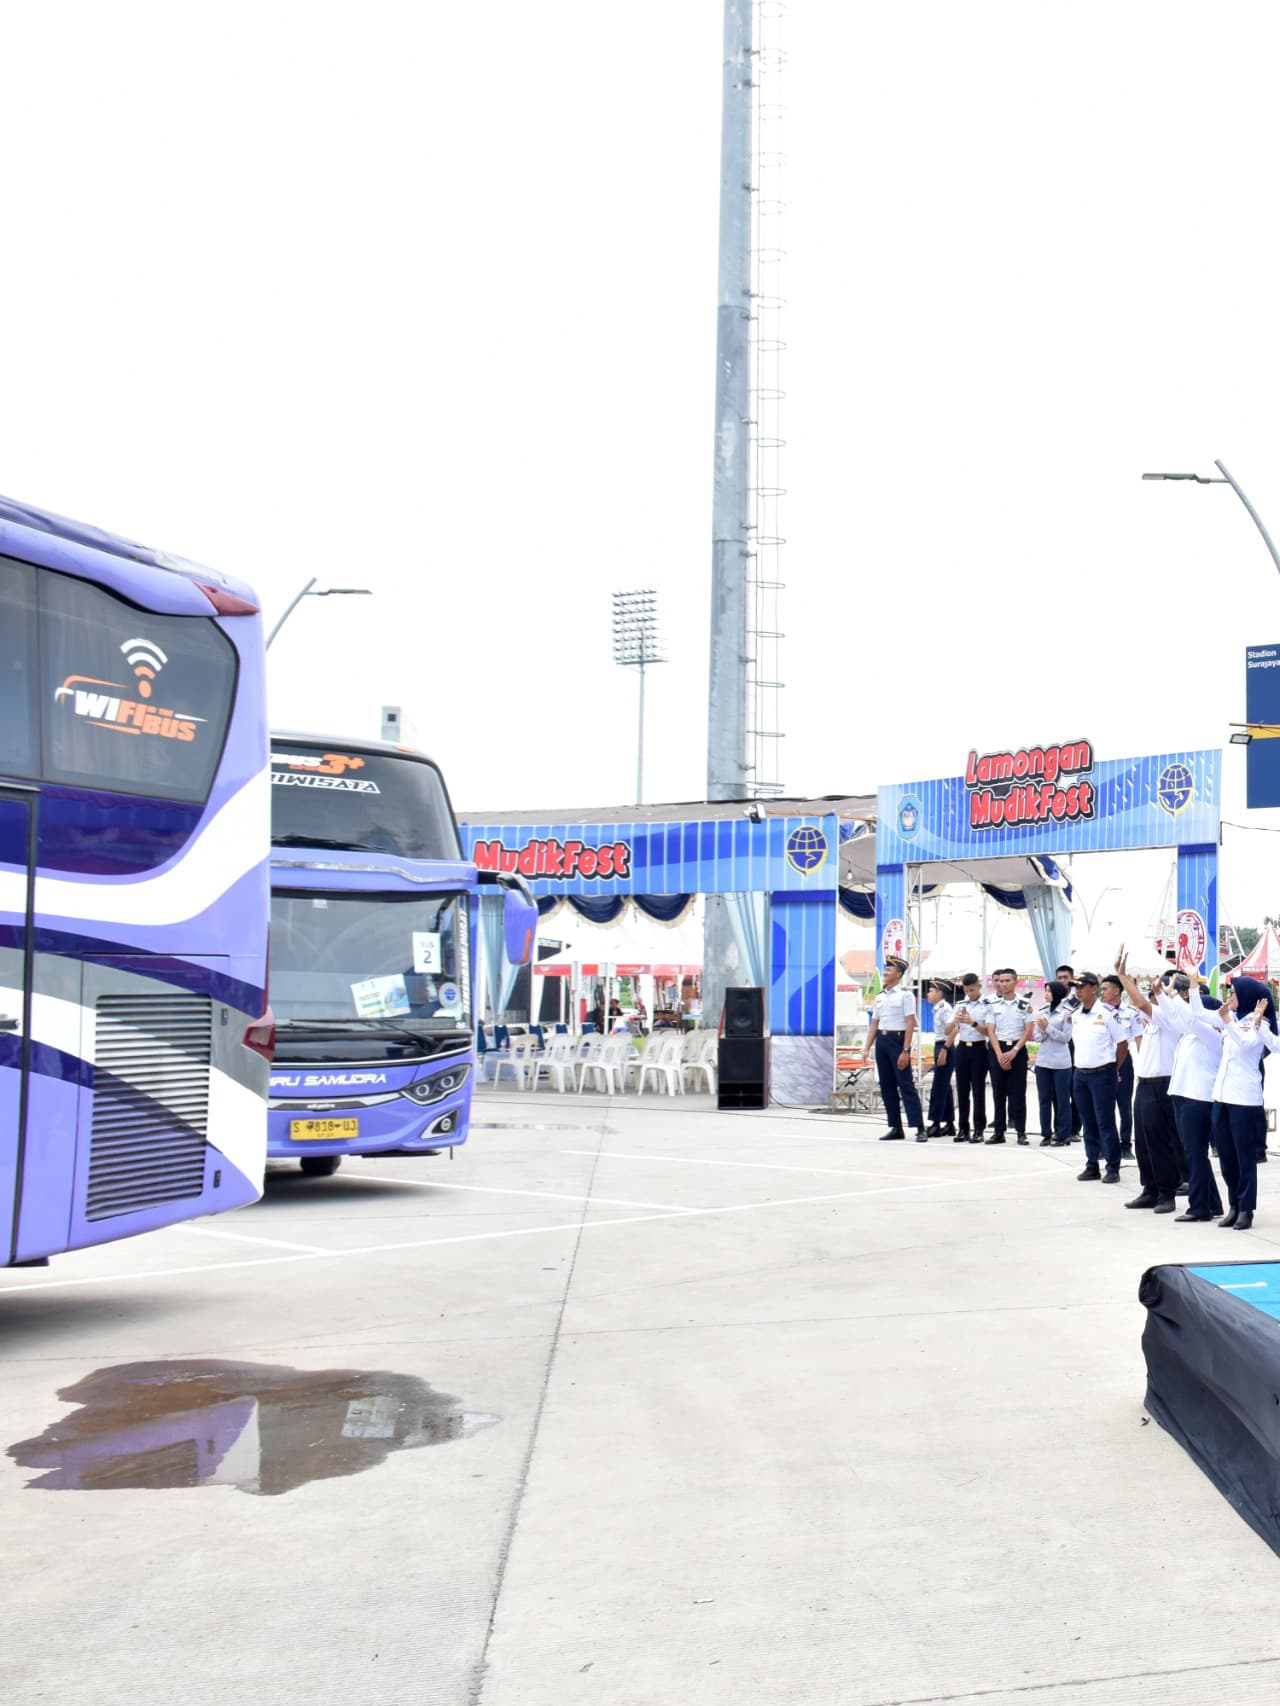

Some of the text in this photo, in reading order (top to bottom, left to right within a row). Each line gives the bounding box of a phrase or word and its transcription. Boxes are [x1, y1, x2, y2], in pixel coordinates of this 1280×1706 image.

[1247, 650, 1277, 659] Stadion
[1247, 660, 1280, 669] Surajaya
[74, 690, 148, 727] WIFI
[141, 714, 197, 742] BUS
[965, 739, 1094, 789] Lamongan
[970, 781, 1096, 829] MudikFest
[474, 839, 631, 880] MudikFest
[423, 950, 432, 964] 2
[303, 1073, 387, 1086] SAMUDRA
[293, 1122, 300, 1132] S
